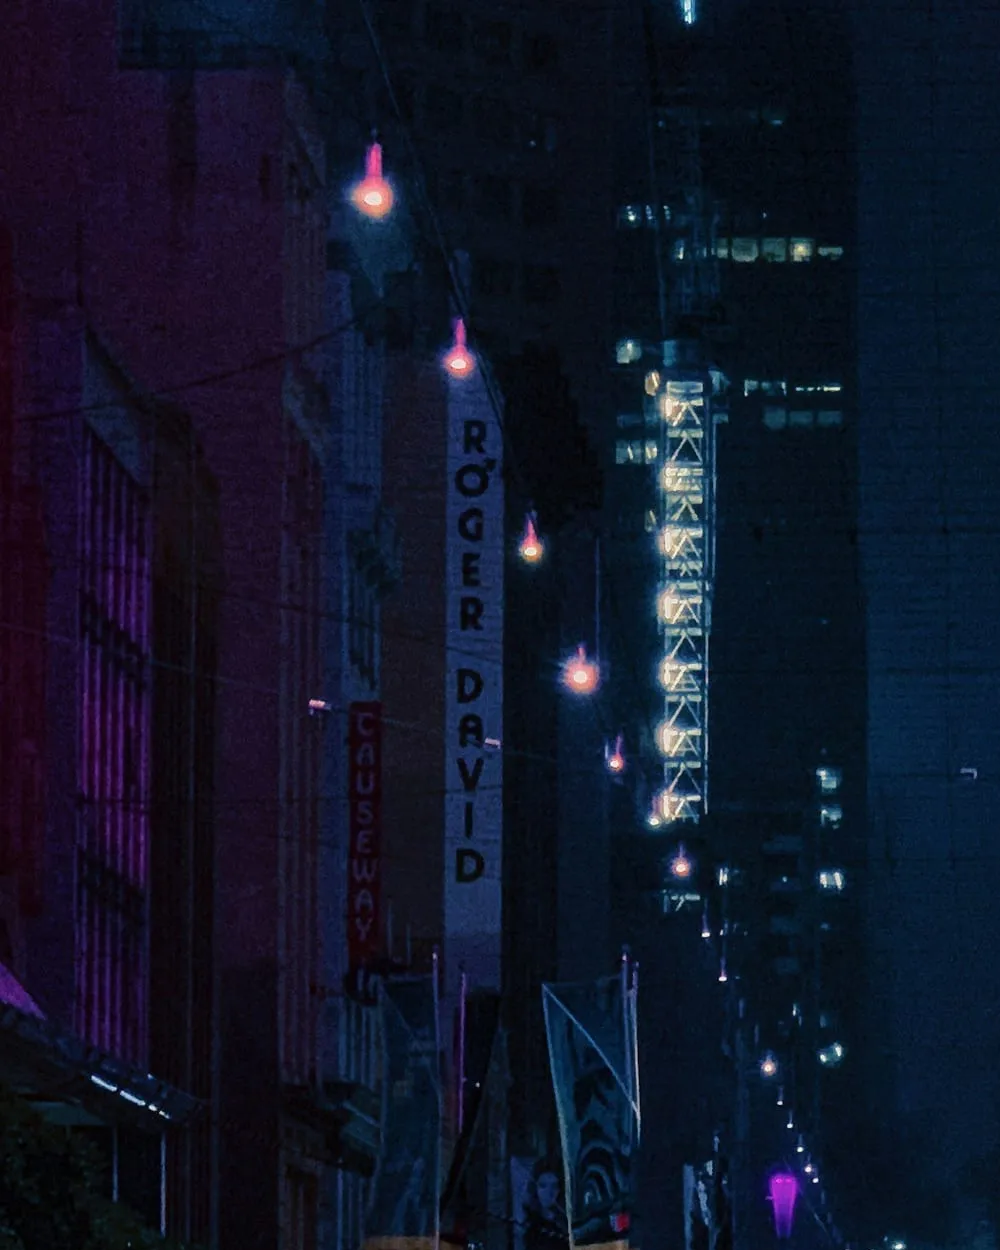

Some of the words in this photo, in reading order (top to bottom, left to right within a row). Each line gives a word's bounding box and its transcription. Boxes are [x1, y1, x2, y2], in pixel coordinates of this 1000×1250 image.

[454, 419, 487, 632] ROGER
[352, 711, 379, 943] CAUSEWAY
[456, 668, 486, 884] DAVID
